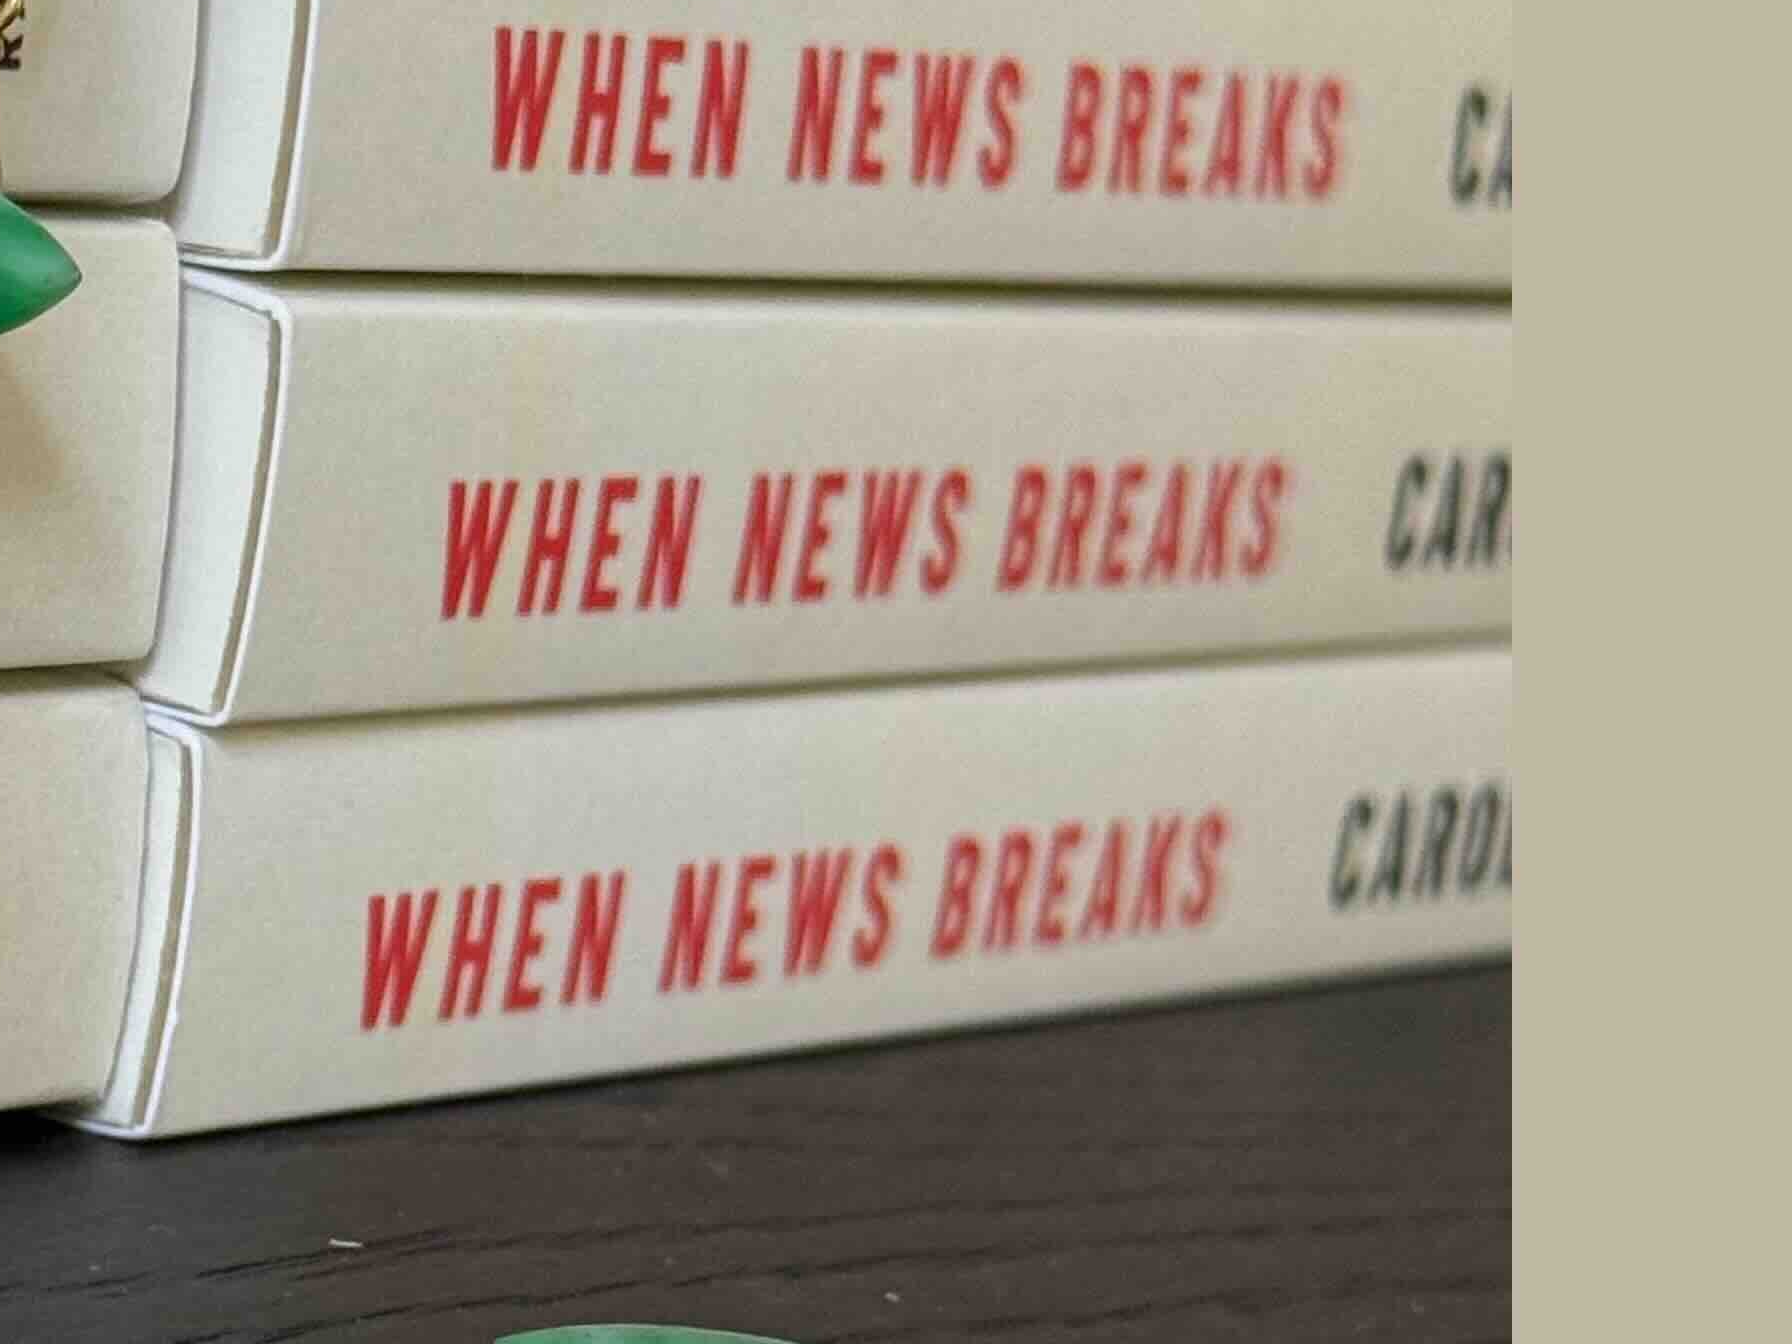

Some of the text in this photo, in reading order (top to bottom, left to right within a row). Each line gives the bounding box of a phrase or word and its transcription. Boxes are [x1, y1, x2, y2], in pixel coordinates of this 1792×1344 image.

[492, 25, 750, 179] WHEN
[787, 46, 1028, 189] NEWS
[1057, 61, 1347, 202] BREAKS
[441, 451, 1512, 619] WHEN NEWS BREAKS CAR
[361, 872, 627, 1029] WHEN
[659, 844, 906, 992] NEWS
[931, 810, 1230, 960] BREAKS
